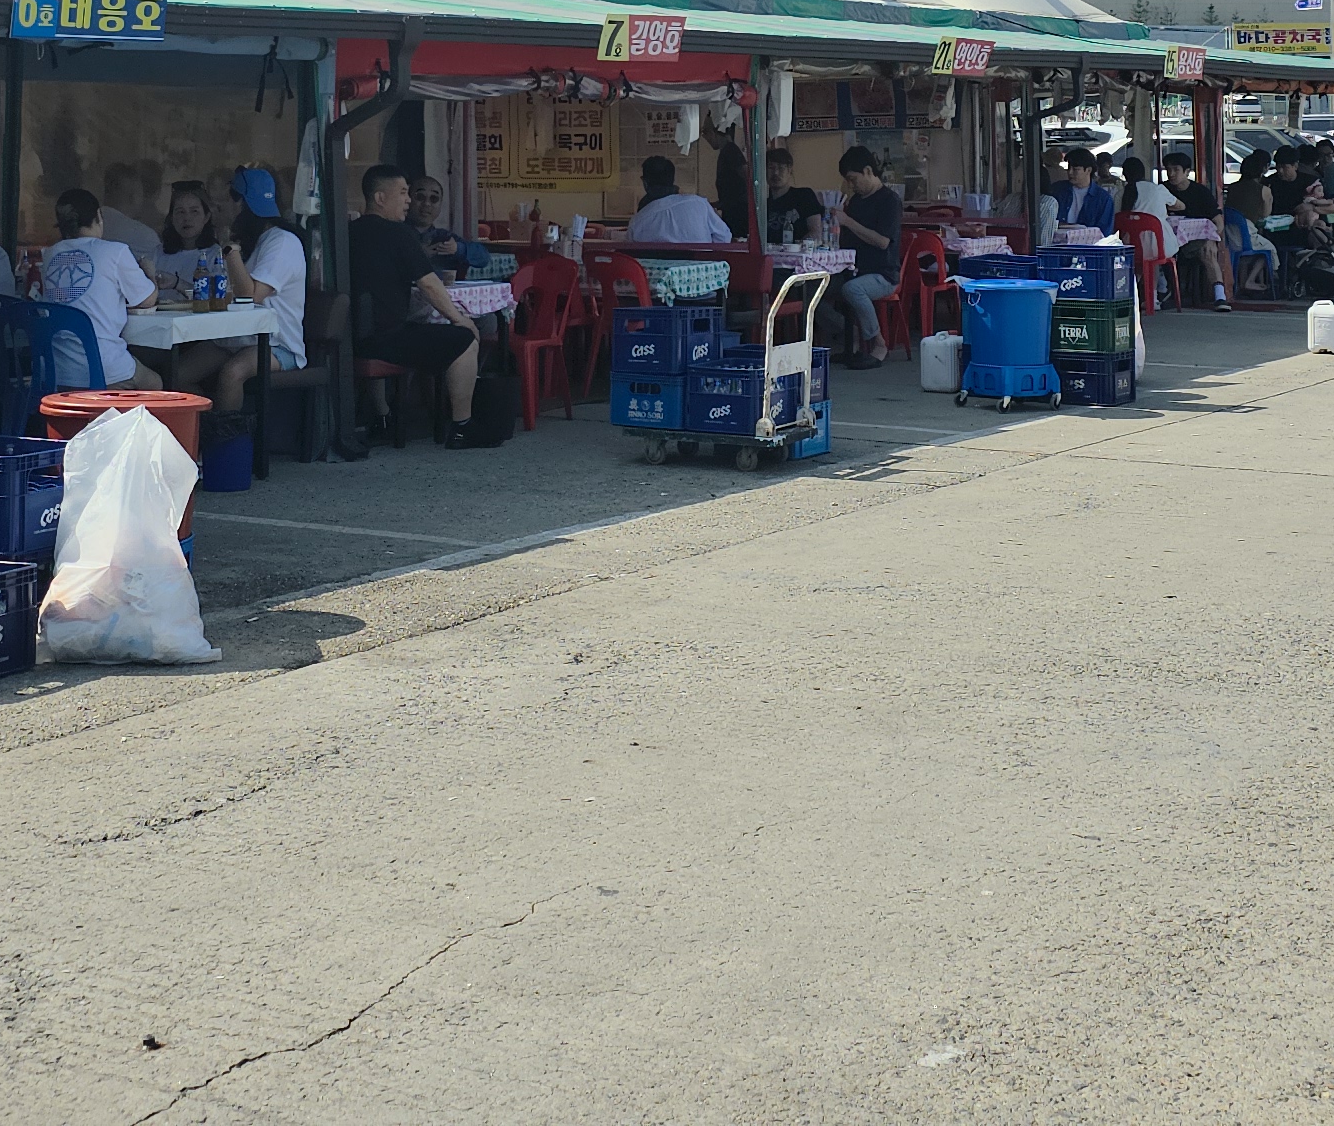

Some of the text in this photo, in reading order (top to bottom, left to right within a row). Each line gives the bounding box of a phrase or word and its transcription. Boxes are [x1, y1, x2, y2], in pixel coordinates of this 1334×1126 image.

[630, 20, 683, 56] 길영호
[954, 42, 991, 70] 연안호
[1179, 50, 1205, 75] 용신호
[526, 157, 604, 175] 도루묵찌개
[1060, 275, 1083, 292] Cass
[632, 344, 655, 357] Cass
[692, 343, 709, 361] Cass
[708, 404, 732, 420] Cass
[40, 503, 62, 528] Cas
